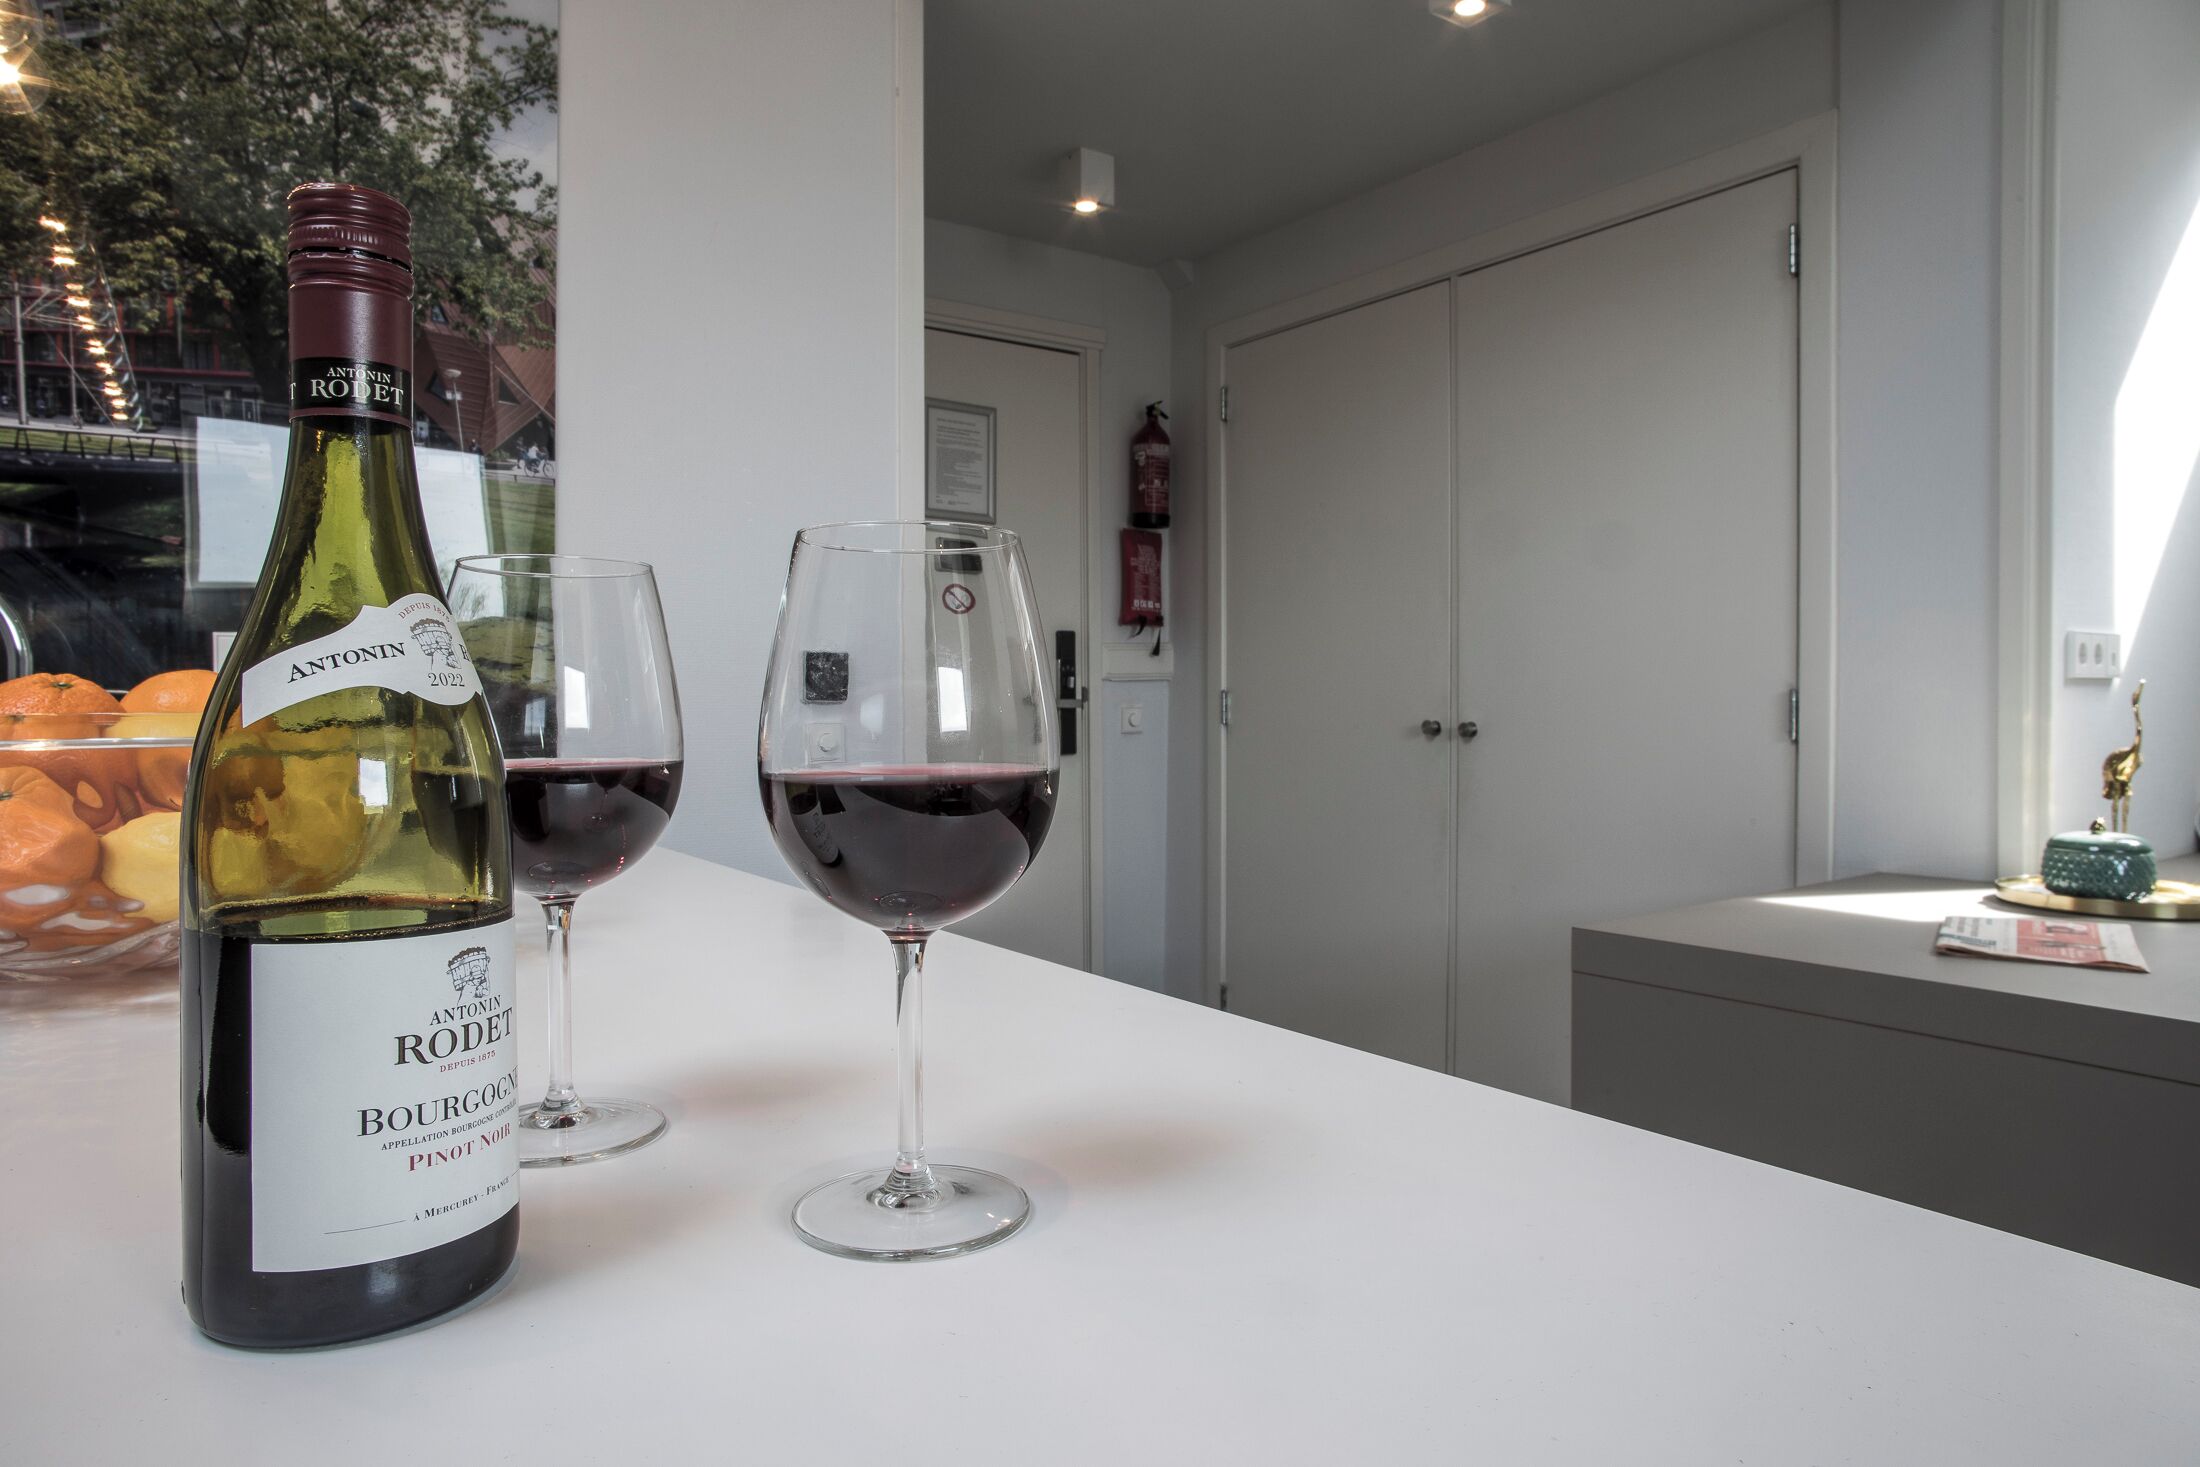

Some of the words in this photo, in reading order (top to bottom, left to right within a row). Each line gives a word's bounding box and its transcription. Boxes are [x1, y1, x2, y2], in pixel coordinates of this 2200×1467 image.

[327, 366, 391, 384] ANTONIN
[310, 379, 404, 406] RODET
[398, 602, 431, 619] DEPUIS
[287, 642, 406, 684] ANTONIN
[427, 672, 466, 687] 2022
[429, 994, 502, 1026] ANTONIN
[394, 1007, 513, 1066] RODET
[440, 1057, 476, 1073] DEPUIS
[478, 1050, 496, 1063] 1875
[382, 1129, 449, 1151] APPELLATION
[451, 1113, 494, 1136] BOURGOGNE
[407, 1140, 475, 1172] PINOT
[480, 1122, 511, 1151] NOIR
[424, 1193, 480, 1219] MERCUREY
[486, 1176, 510, 1196] FRANCE
